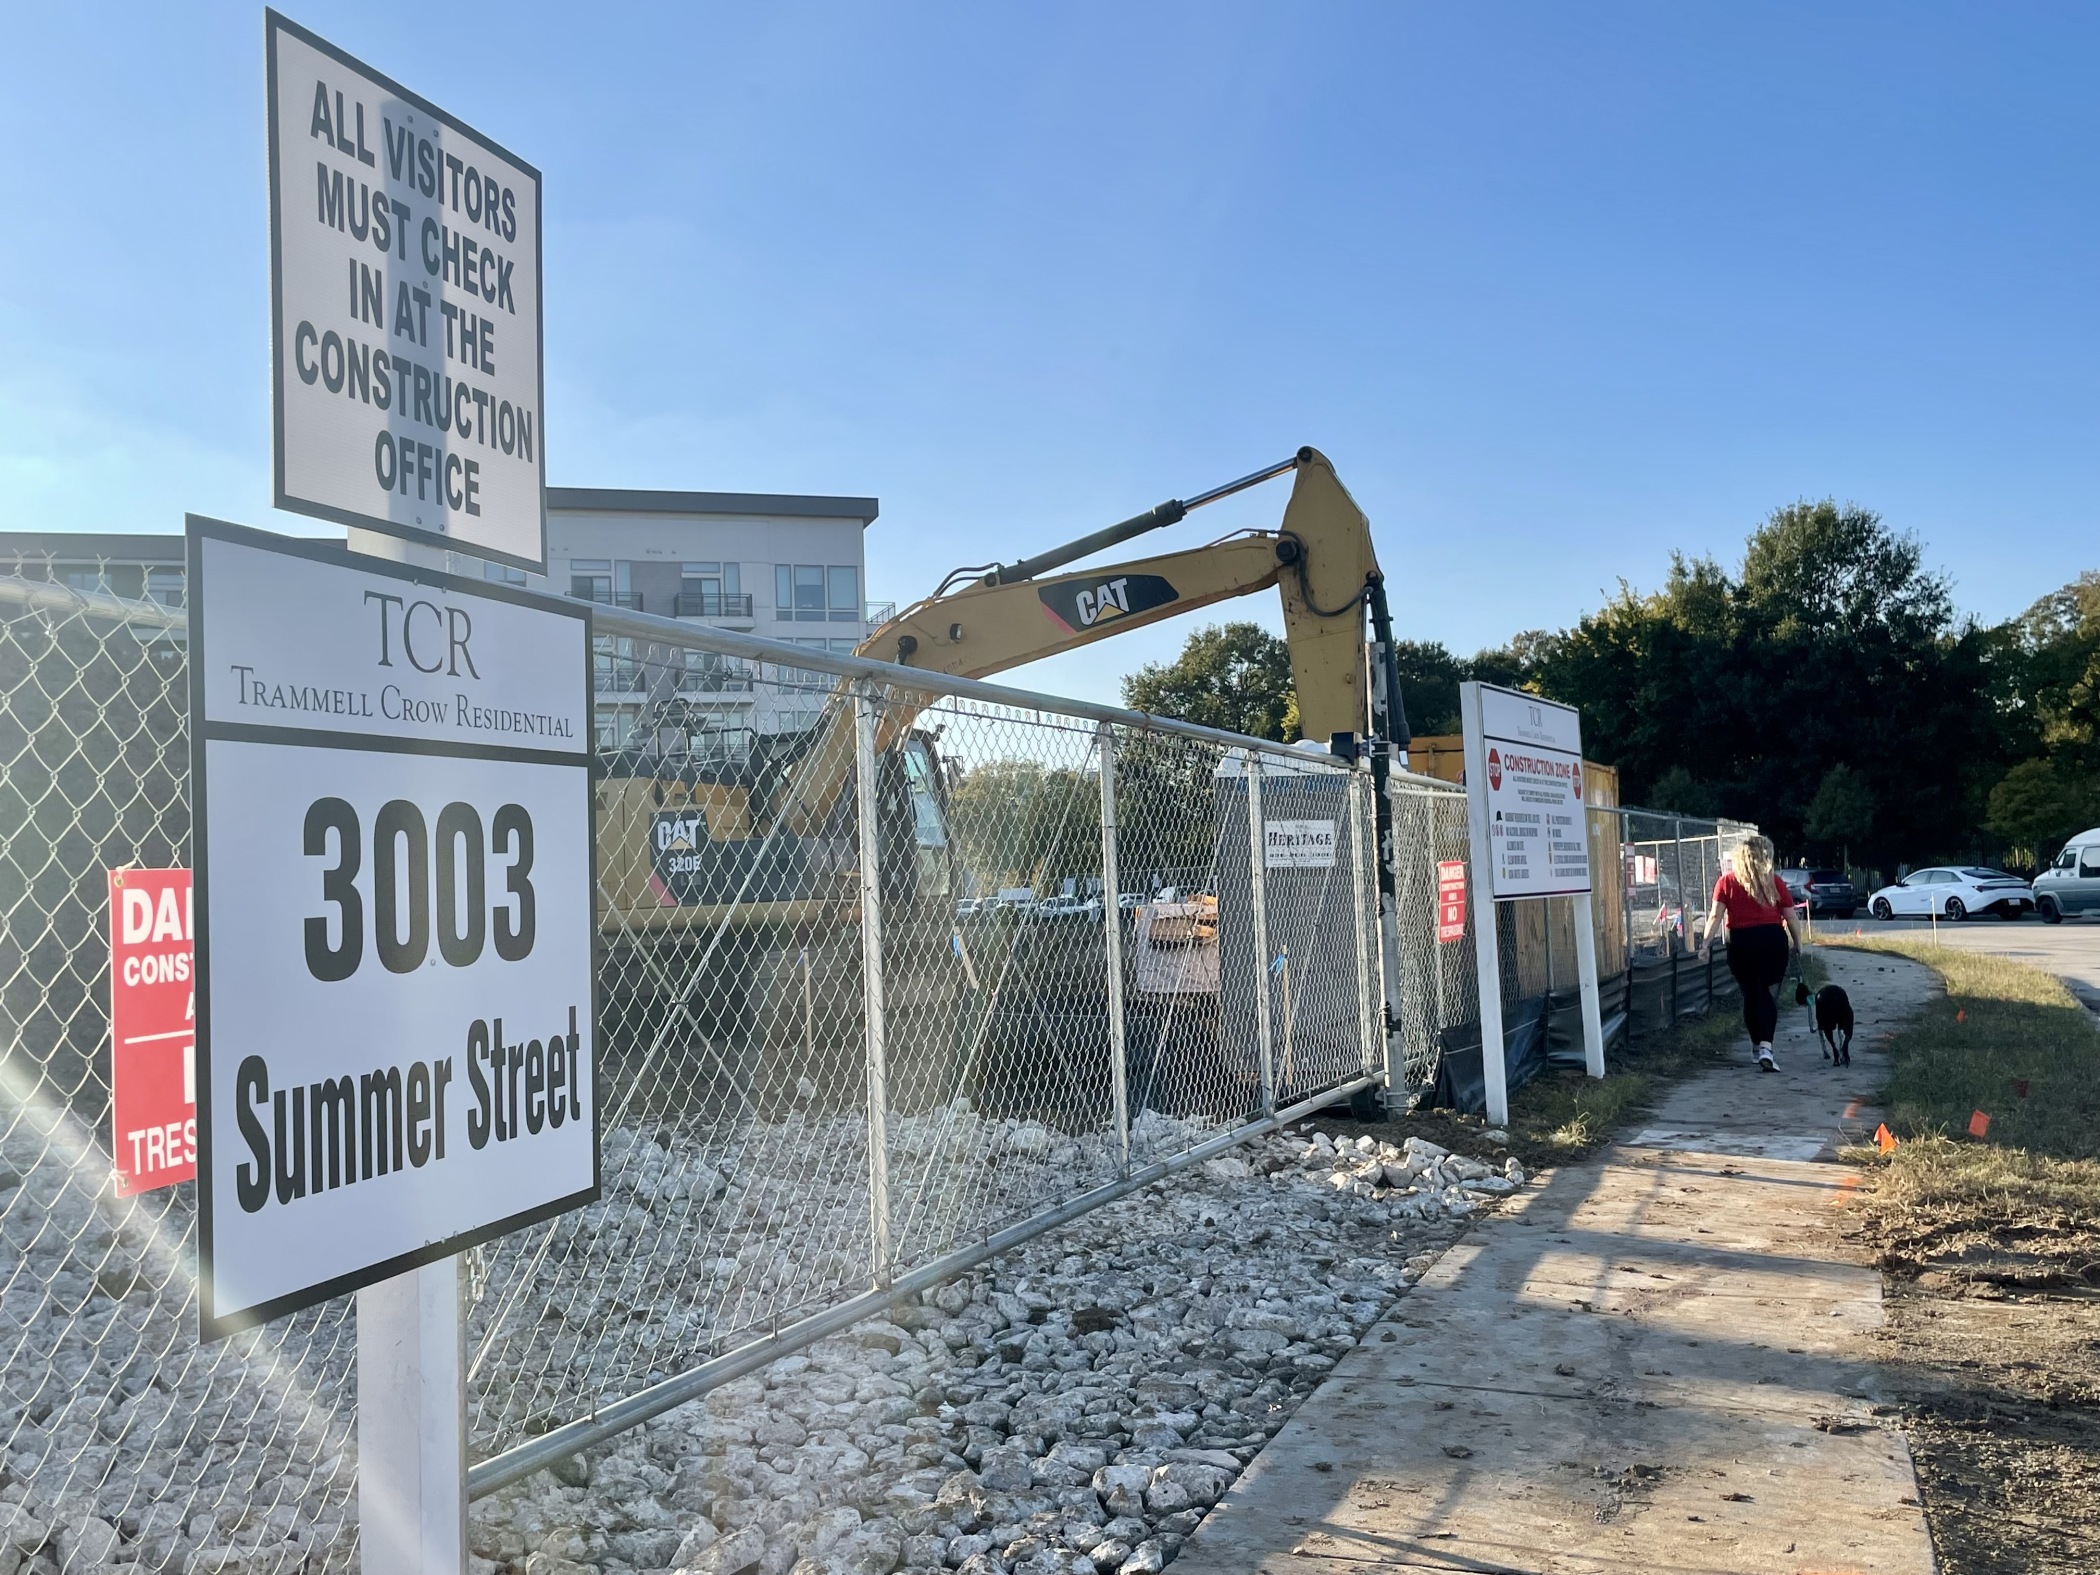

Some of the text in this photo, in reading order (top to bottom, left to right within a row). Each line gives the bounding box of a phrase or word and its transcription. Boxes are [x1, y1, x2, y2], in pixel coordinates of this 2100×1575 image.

[310, 80, 517, 244] ALL VISITORS
[316, 161, 516, 315] MUST CHECK
[348, 257, 495, 377] IN AT THE
[294, 320, 534, 464] CONSTRUCTION
[374, 429, 481, 518] OFFICE
[363, 590, 481, 680] TCR
[1076, 578, 1129, 625] CAT
[230, 665, 574, 739] TRAMMELL CROW RESIDENTIAL
[1504, 753, 1571, 780] CONSTRUCTION ZONE
[657, 820, 699, 850] CAT
[303, 796, 536, 983] 3003
[1441, 864, 1464, 881] DANGER
[122, 887, 193, 944] DA
[1447, 906, 1457, 922] NO
[123, 953, 194, 987] CONS
[128, 1117, 196, 1175] TRES
[235, 1005, 581, 1214] Summer Street
